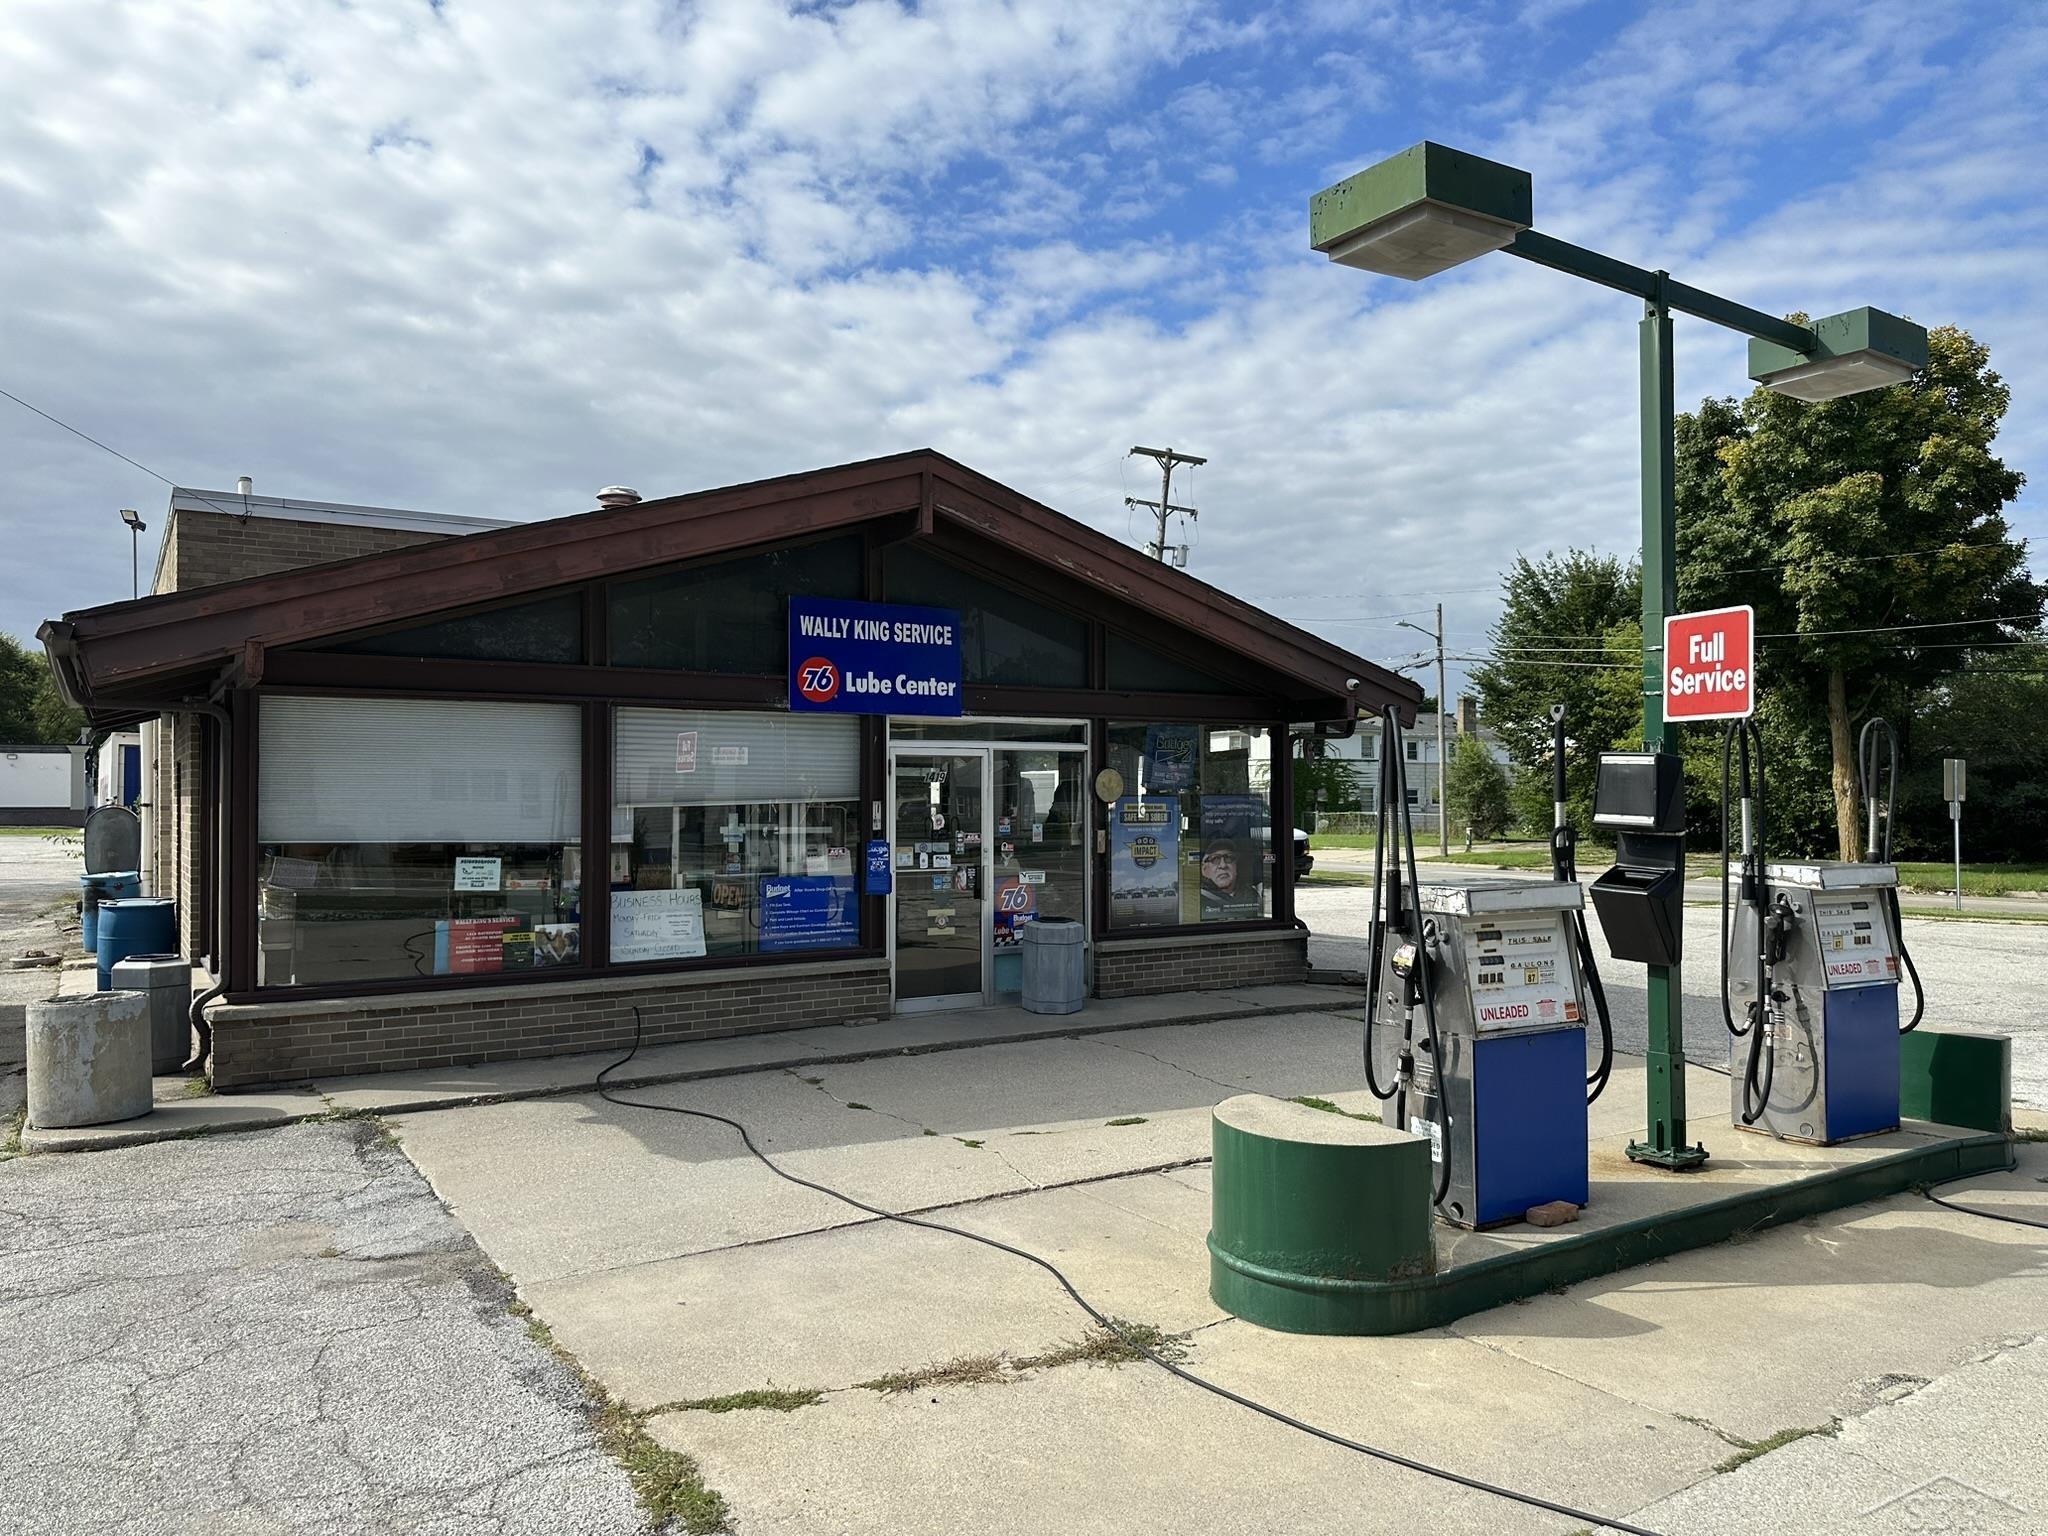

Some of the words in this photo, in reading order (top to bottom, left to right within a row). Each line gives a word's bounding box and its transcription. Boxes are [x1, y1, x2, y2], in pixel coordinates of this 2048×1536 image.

[800, 615, 850, 638] WALLY
[854, 619, 890, 642] KING
[894, 622, 952, 645] SERVICE
[1689, 631, 1725, 665] Full
[802, 665, 834, 692] 76
[845, 671, 892, 694] Lube
[895, 674, 957, 697] Center
[1669, 662, 1746, 696] Service
[1134, 846, 1157, 856] IMPACT
[713, 884, 744, 906] OPEN
[1001, 884, 1028, 911] 76
[1013, 914, 1033, 922] Budget
[1508, 937, 1526, 945] THIS
[1532, 936, 1552, 944] SALE
[1510, 960, 1555, 969] GALLONS
[1827, 963, 1862, 976] UNLEADED
[1527, 973, 1536, 983] 87
[1480, 1004, 1529, 1021] UNLEADED
